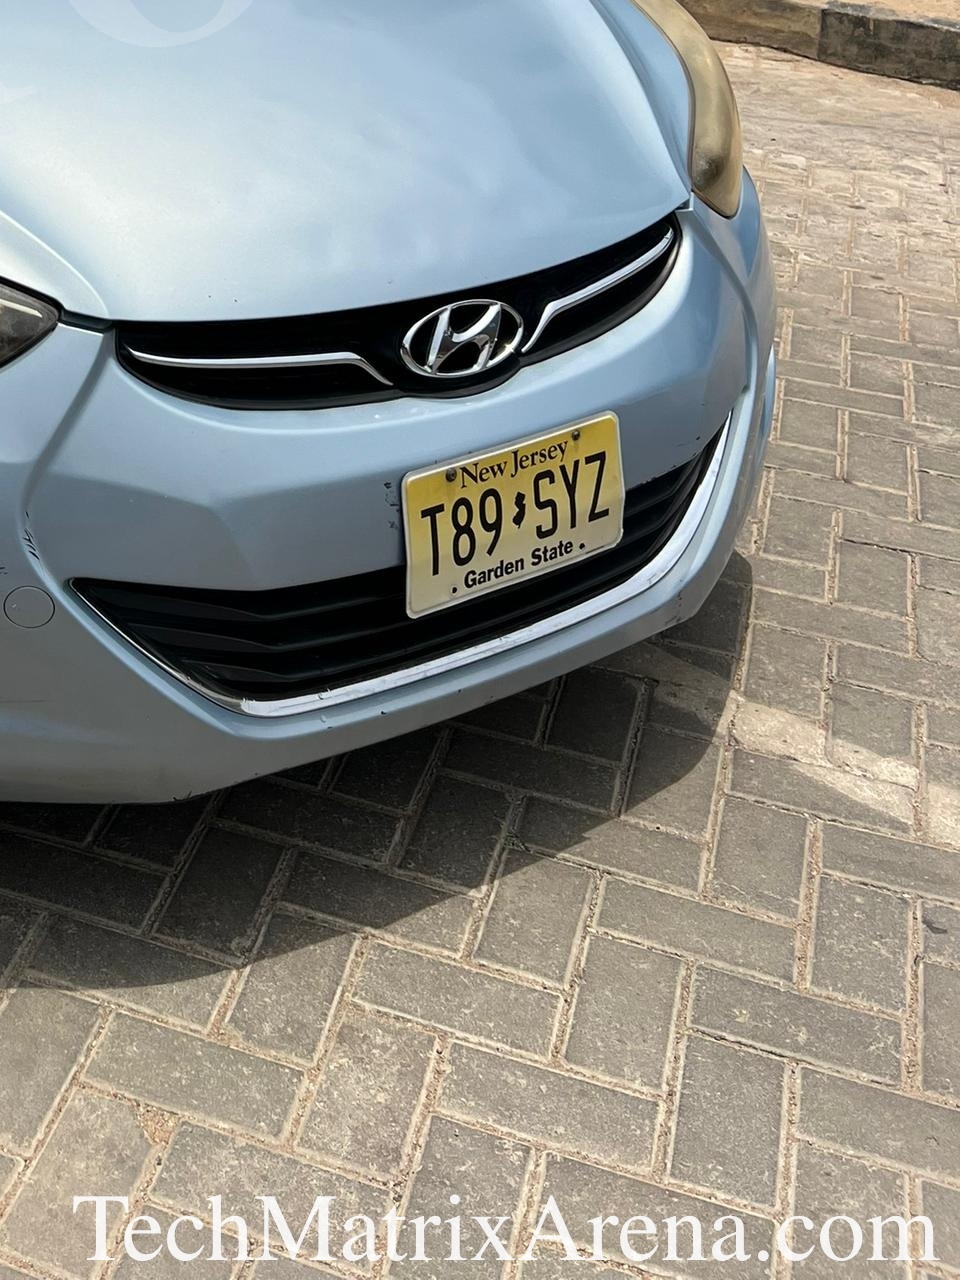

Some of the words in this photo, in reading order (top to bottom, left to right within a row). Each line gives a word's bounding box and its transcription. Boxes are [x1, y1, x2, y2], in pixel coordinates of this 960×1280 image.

[459, 460, 508, 489] New
[511, 440, 569, 478] Jersey
[464, 558, 525, 589] Garden
[530, 540, 574, 567] State
